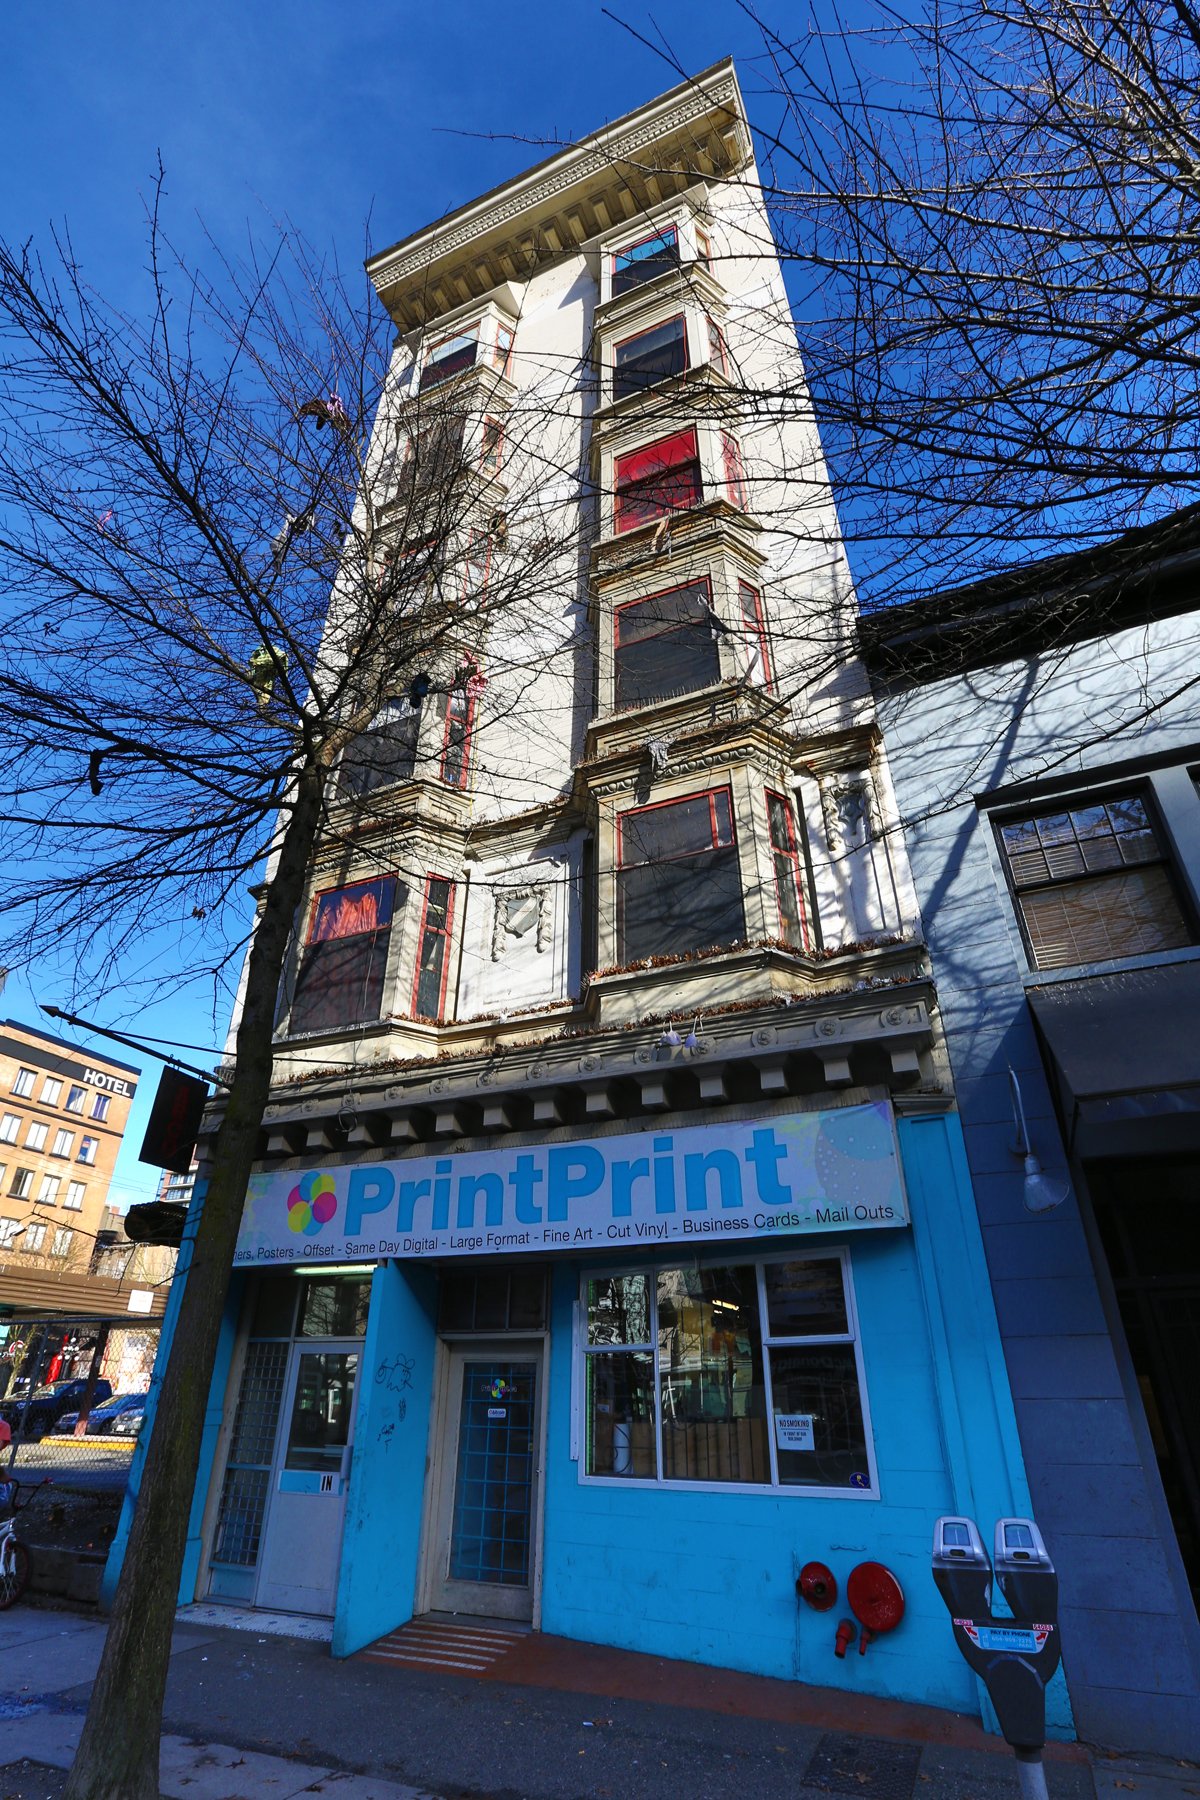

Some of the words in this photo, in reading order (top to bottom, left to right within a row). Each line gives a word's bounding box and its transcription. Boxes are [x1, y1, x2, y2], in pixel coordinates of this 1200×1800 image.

[83, 1068, 130, 1097] HOTEL
[344, 1128, 792, 1236] PrintPrint
[257, 1247, 294, 1260] Posters
[303, 1244, 334, 1256] Offset
[345, 1242, 376, 1255] Same
[378, 1240, 400, 1254] Day
[403, 1236, 438, 1254] Digital
[450, 1235, 483, 1250] Large
[486, 1232, 530, 1246] Format
[543, 1229, 570, 1242] Fine
[573, 1227, 593, 1241] Art
[607, 1224, 631, 1239] Cut
[635, 1221, 668, 1239] Vinyl
[683, 1217, 749, 1233] Business
[754, 1211, 800, 1229] Cards
[816, 1207, 849, 1224] Mail
[854, 1204, 894, 1221] Outs
[779, 1419, 787, 1428] NO
[787, 1419, 809, 1428] SMOKING
[321, 1475, 333, 1491] IN
